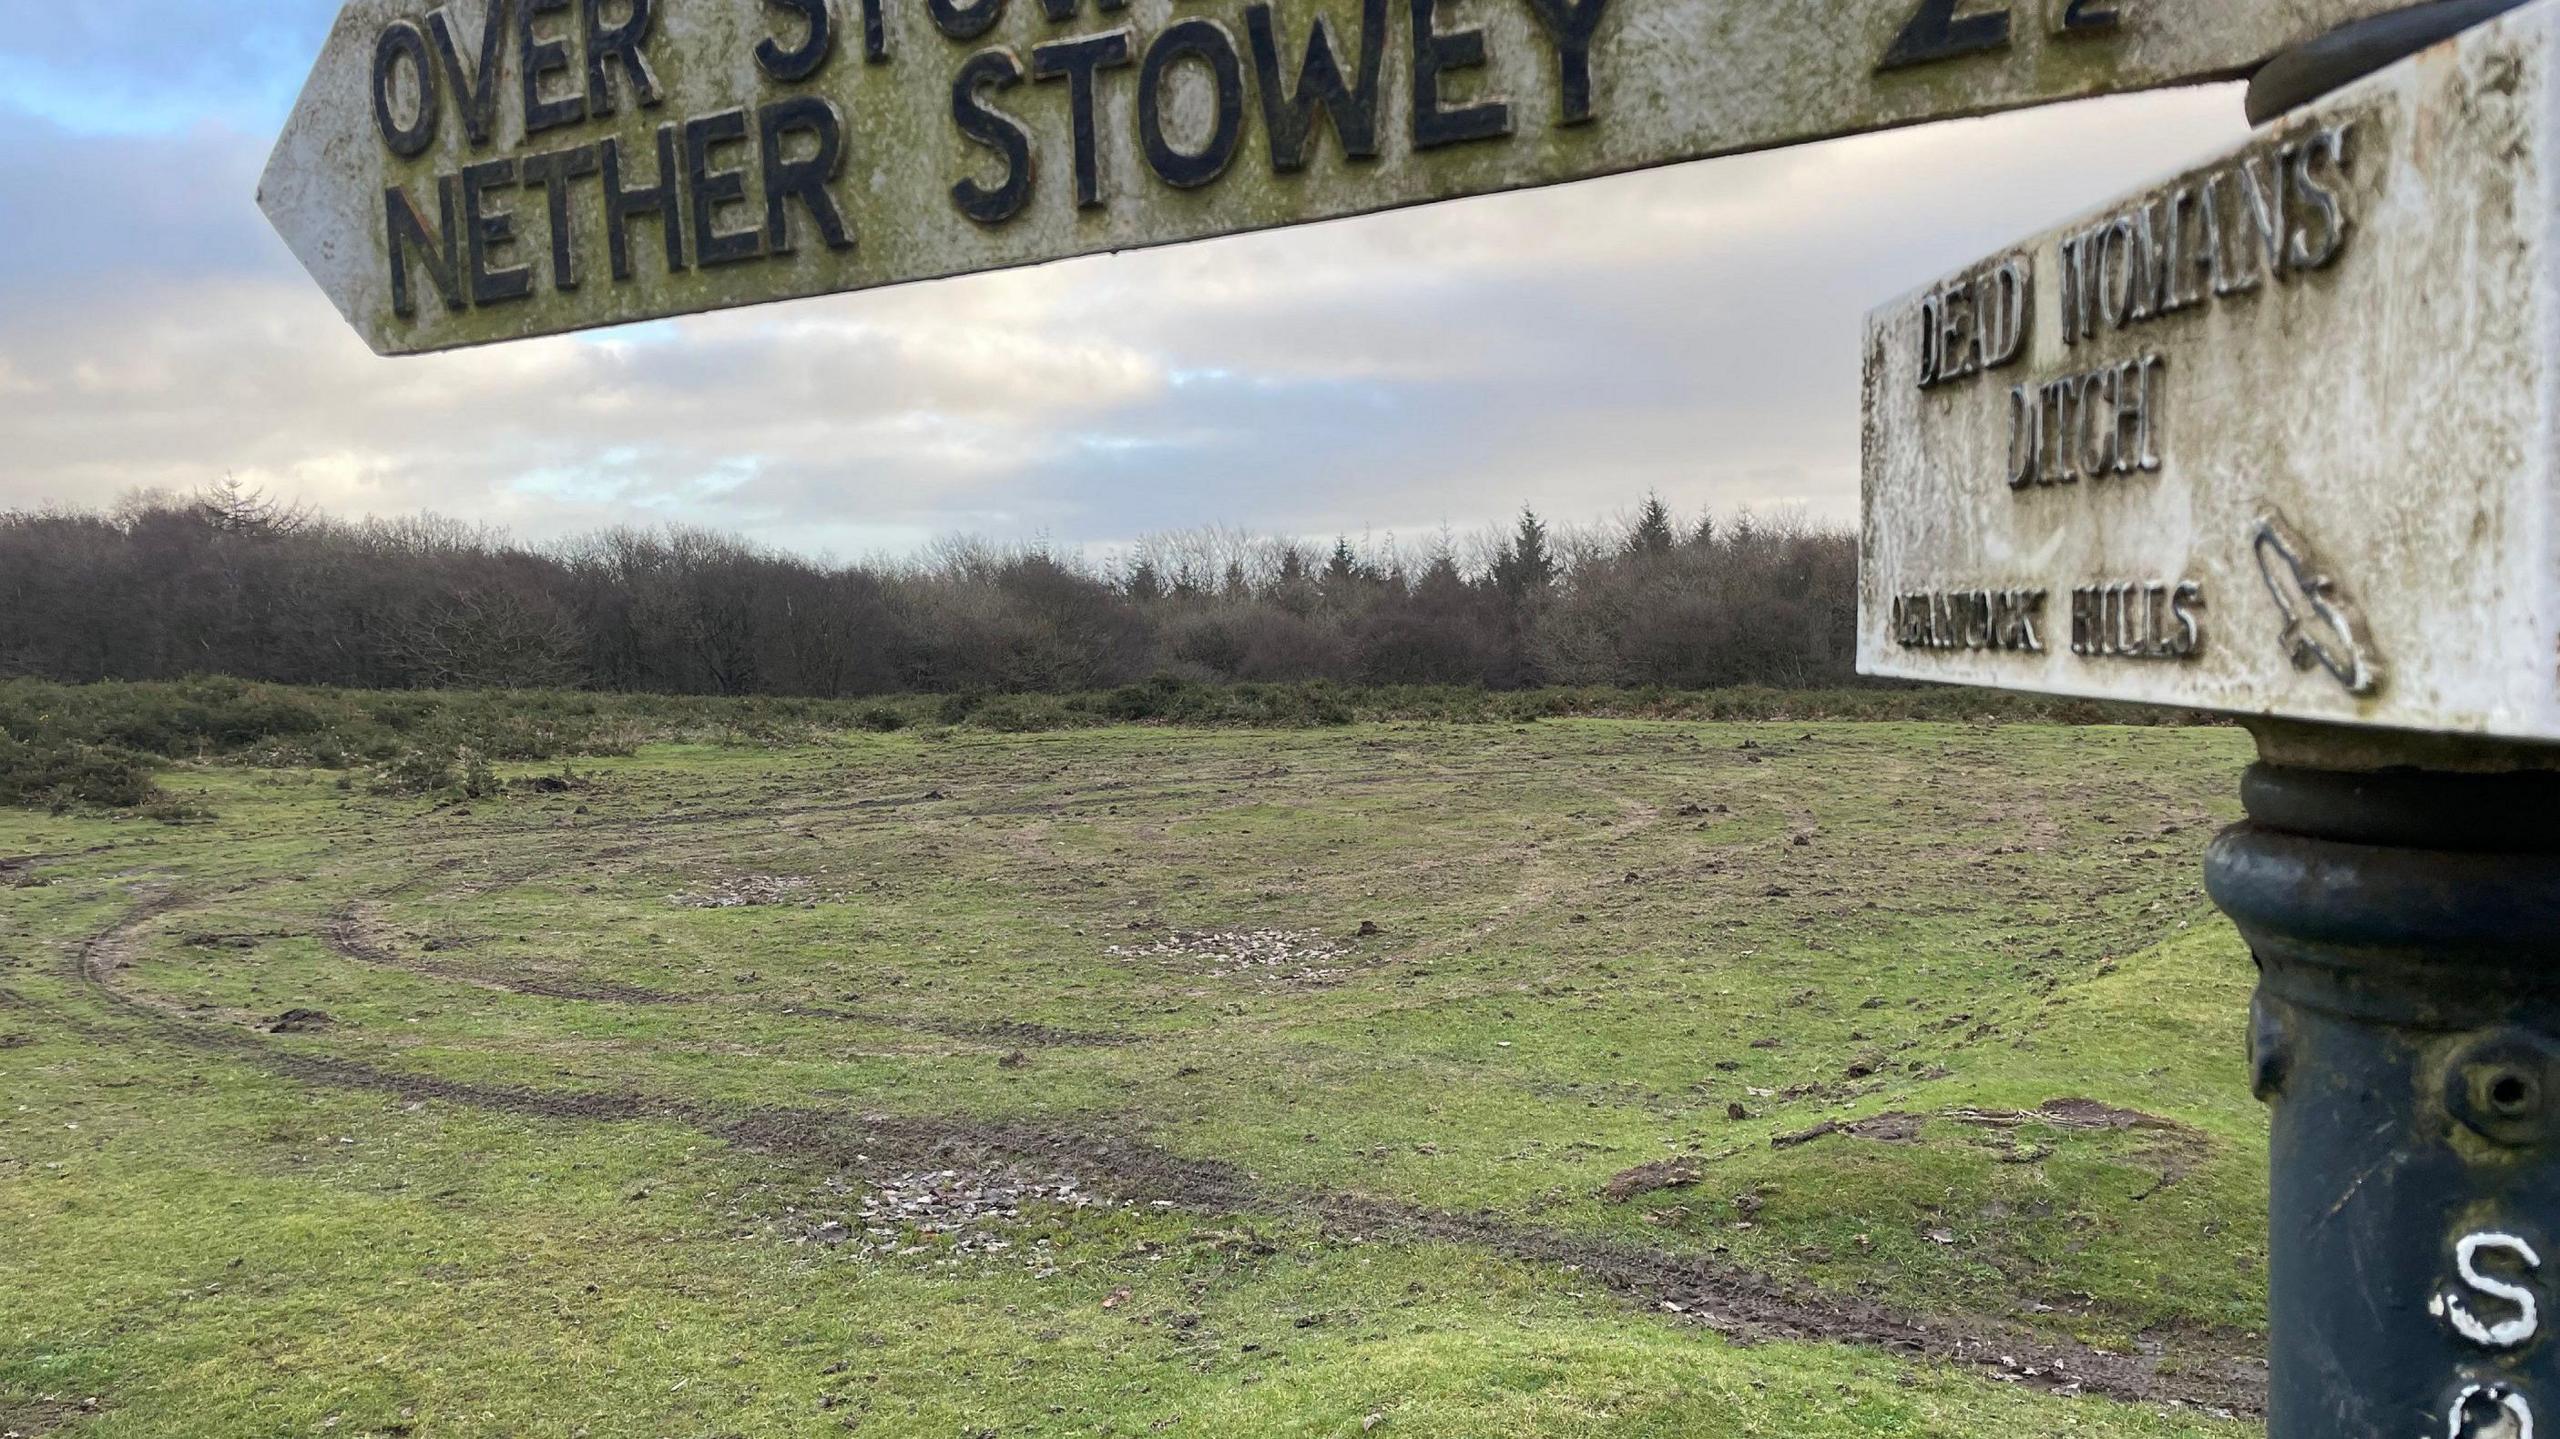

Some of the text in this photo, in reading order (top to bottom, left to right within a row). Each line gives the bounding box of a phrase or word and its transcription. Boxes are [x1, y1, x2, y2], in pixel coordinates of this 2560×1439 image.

[369, 0, 663, 158] OVER
[384, 0, 1603, 318] NETHER STOWEY
[1918, 123, 2356, 389] DEAD WOMANS
[2008, 353, 2166, 491] DITCH
[2070, 579, 2206, 658] HILLS
